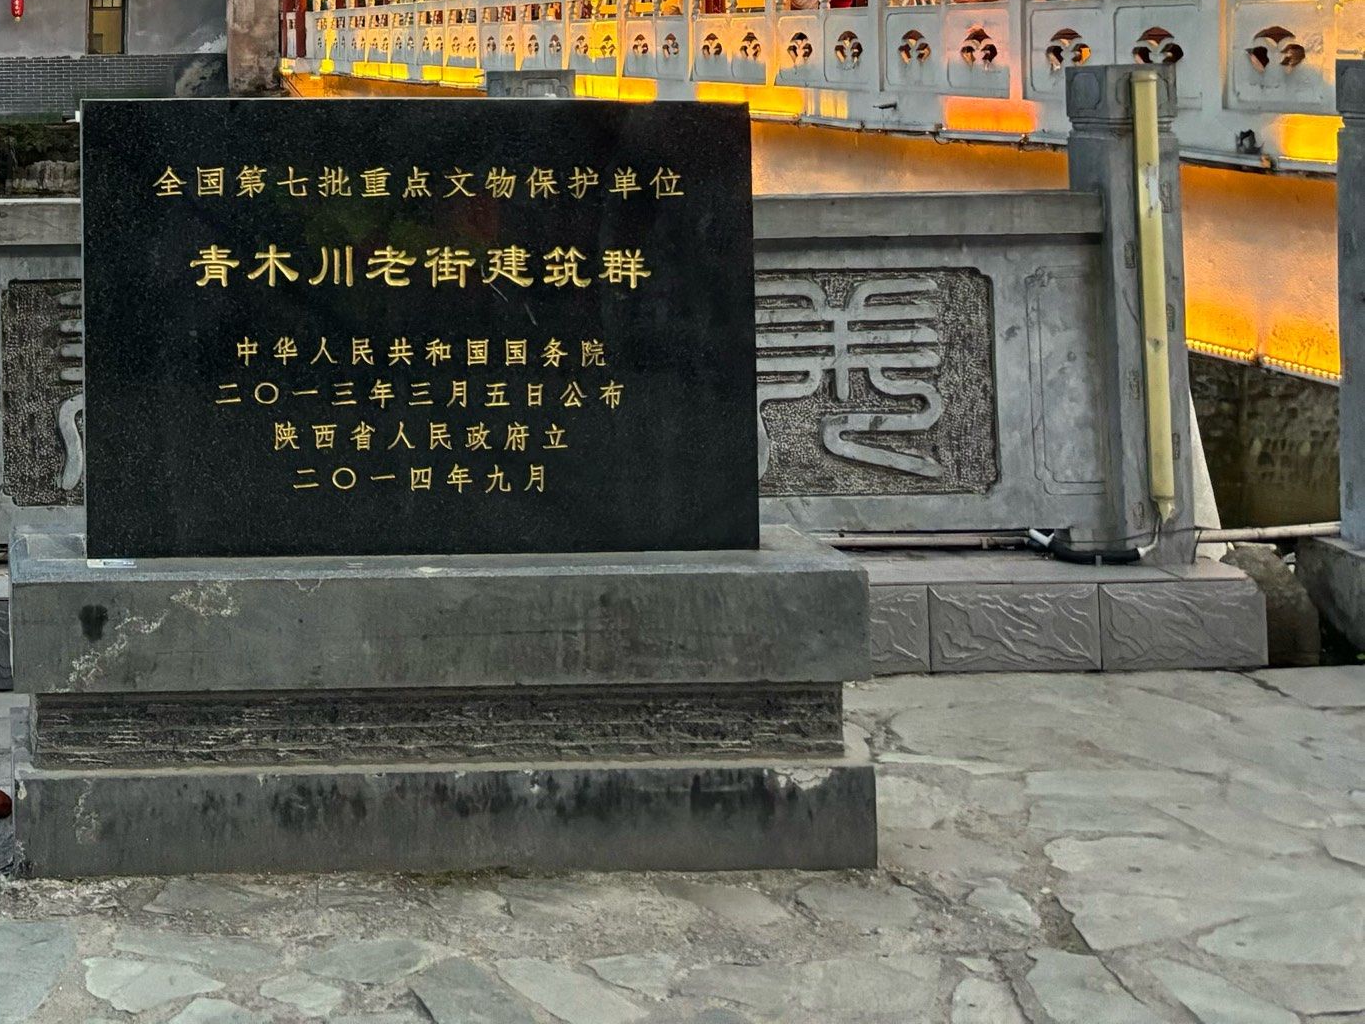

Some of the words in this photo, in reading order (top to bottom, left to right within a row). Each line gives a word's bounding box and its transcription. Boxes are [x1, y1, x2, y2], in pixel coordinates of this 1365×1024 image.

[153, 166, 685, 199] 全国第七批重点文物保护单位
[190, 244, 652, 290] 青木川老街建筑群
[236, 337, 606, 368] 中华人民共和国国务院
[274, 422, 568, 451] 陕西省人民政府立
